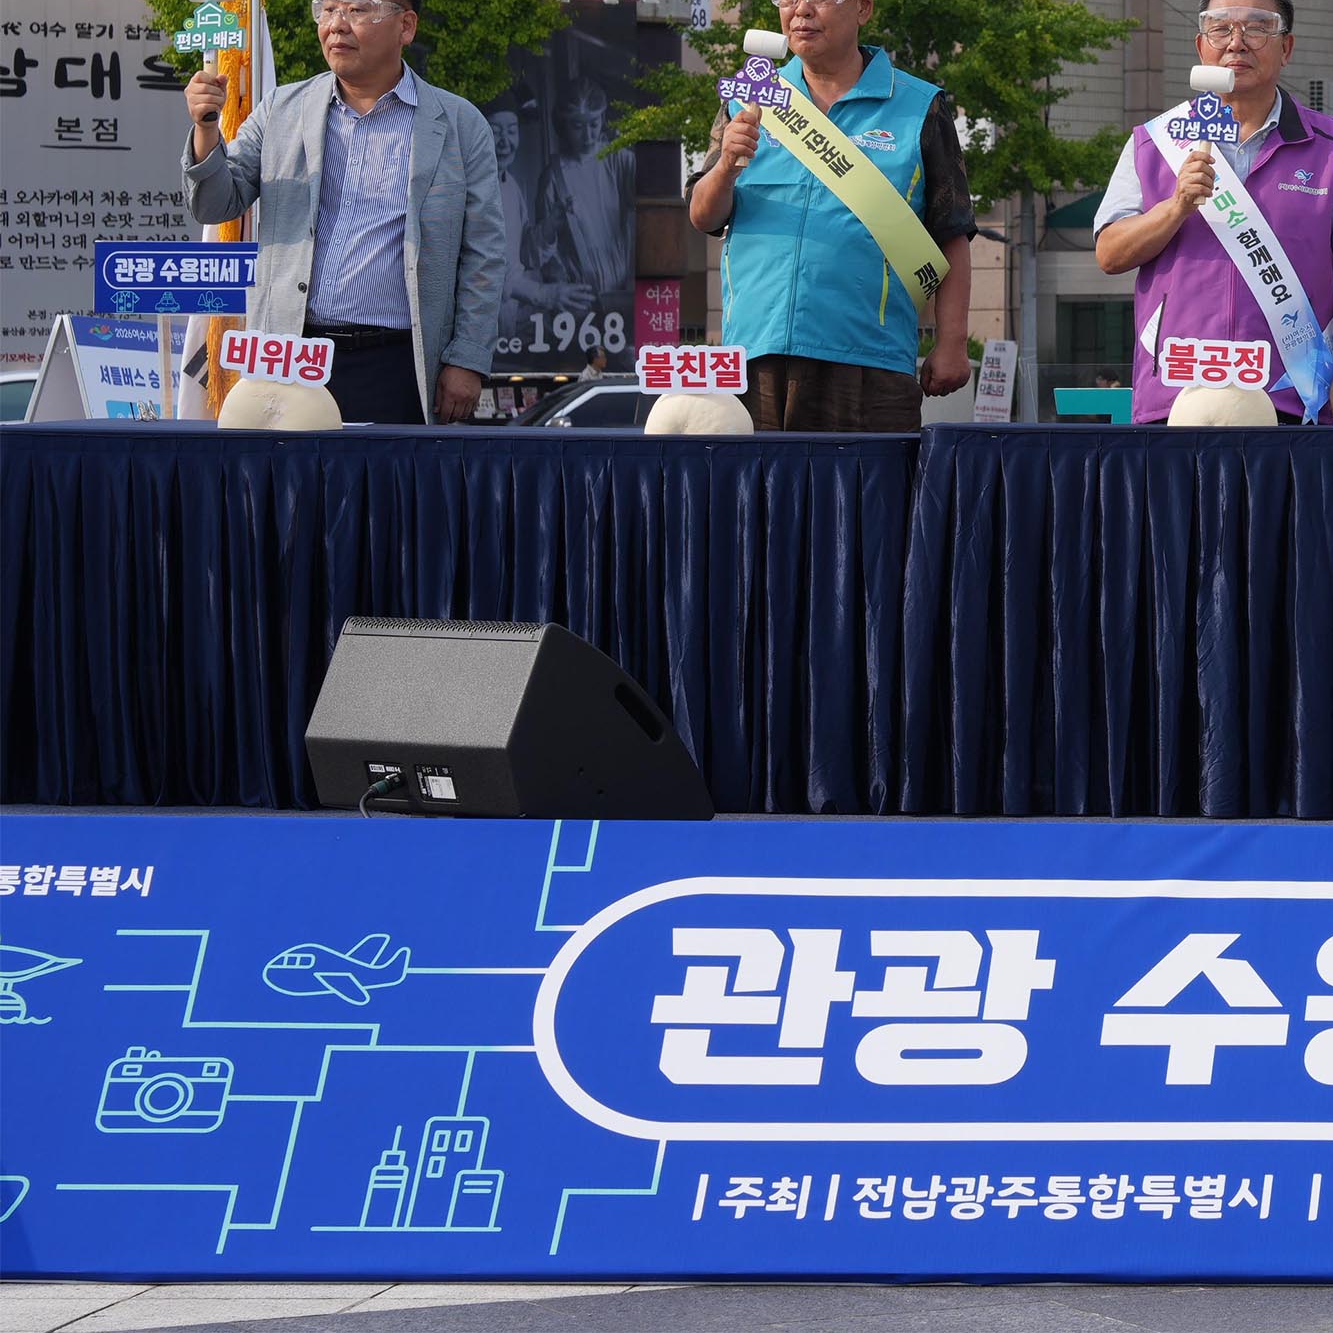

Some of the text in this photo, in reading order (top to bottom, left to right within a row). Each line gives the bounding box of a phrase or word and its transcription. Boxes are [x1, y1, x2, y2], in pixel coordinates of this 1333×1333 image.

[30, 22, 66, 39] 여수
[75, 22, 114, 40] 딸기
[176, 30, 244, 50] 편의·배려
[719, 79, 790, 109] 정직·신뢰
[54, 116, 119, 143] 본점
[1168, 118, 1240, 142] 위생·안심
[14, 190, 94, 208] 오사카에서
[101, 190, 132, 207] 처음
[16, 213, 187, 228] 외할머니의 손맛 그대로
[8, 233, 55, 250] 어머니
[61, 232, 87, 251] 3대
[1213, 189, 1293, 306] 미소 함께해요
[19, 255, 68, 272] 만드는
[114, 258, 240, 283] 관광 수용태세
[528, 312, 627, 354] 1968
[226, 335, 329, 381] 비위생
[641, 351, 742, 389] 불친절
[1164, 343, 1267, 386] 불공정
[99, 364, 148, 388] 셔틀버스
[650, 927, 1056, 1086] 관광
[718, 1173, 811, 1221] 주최
[851, 1172, 1275, 1222] 전남광주통합특별시
